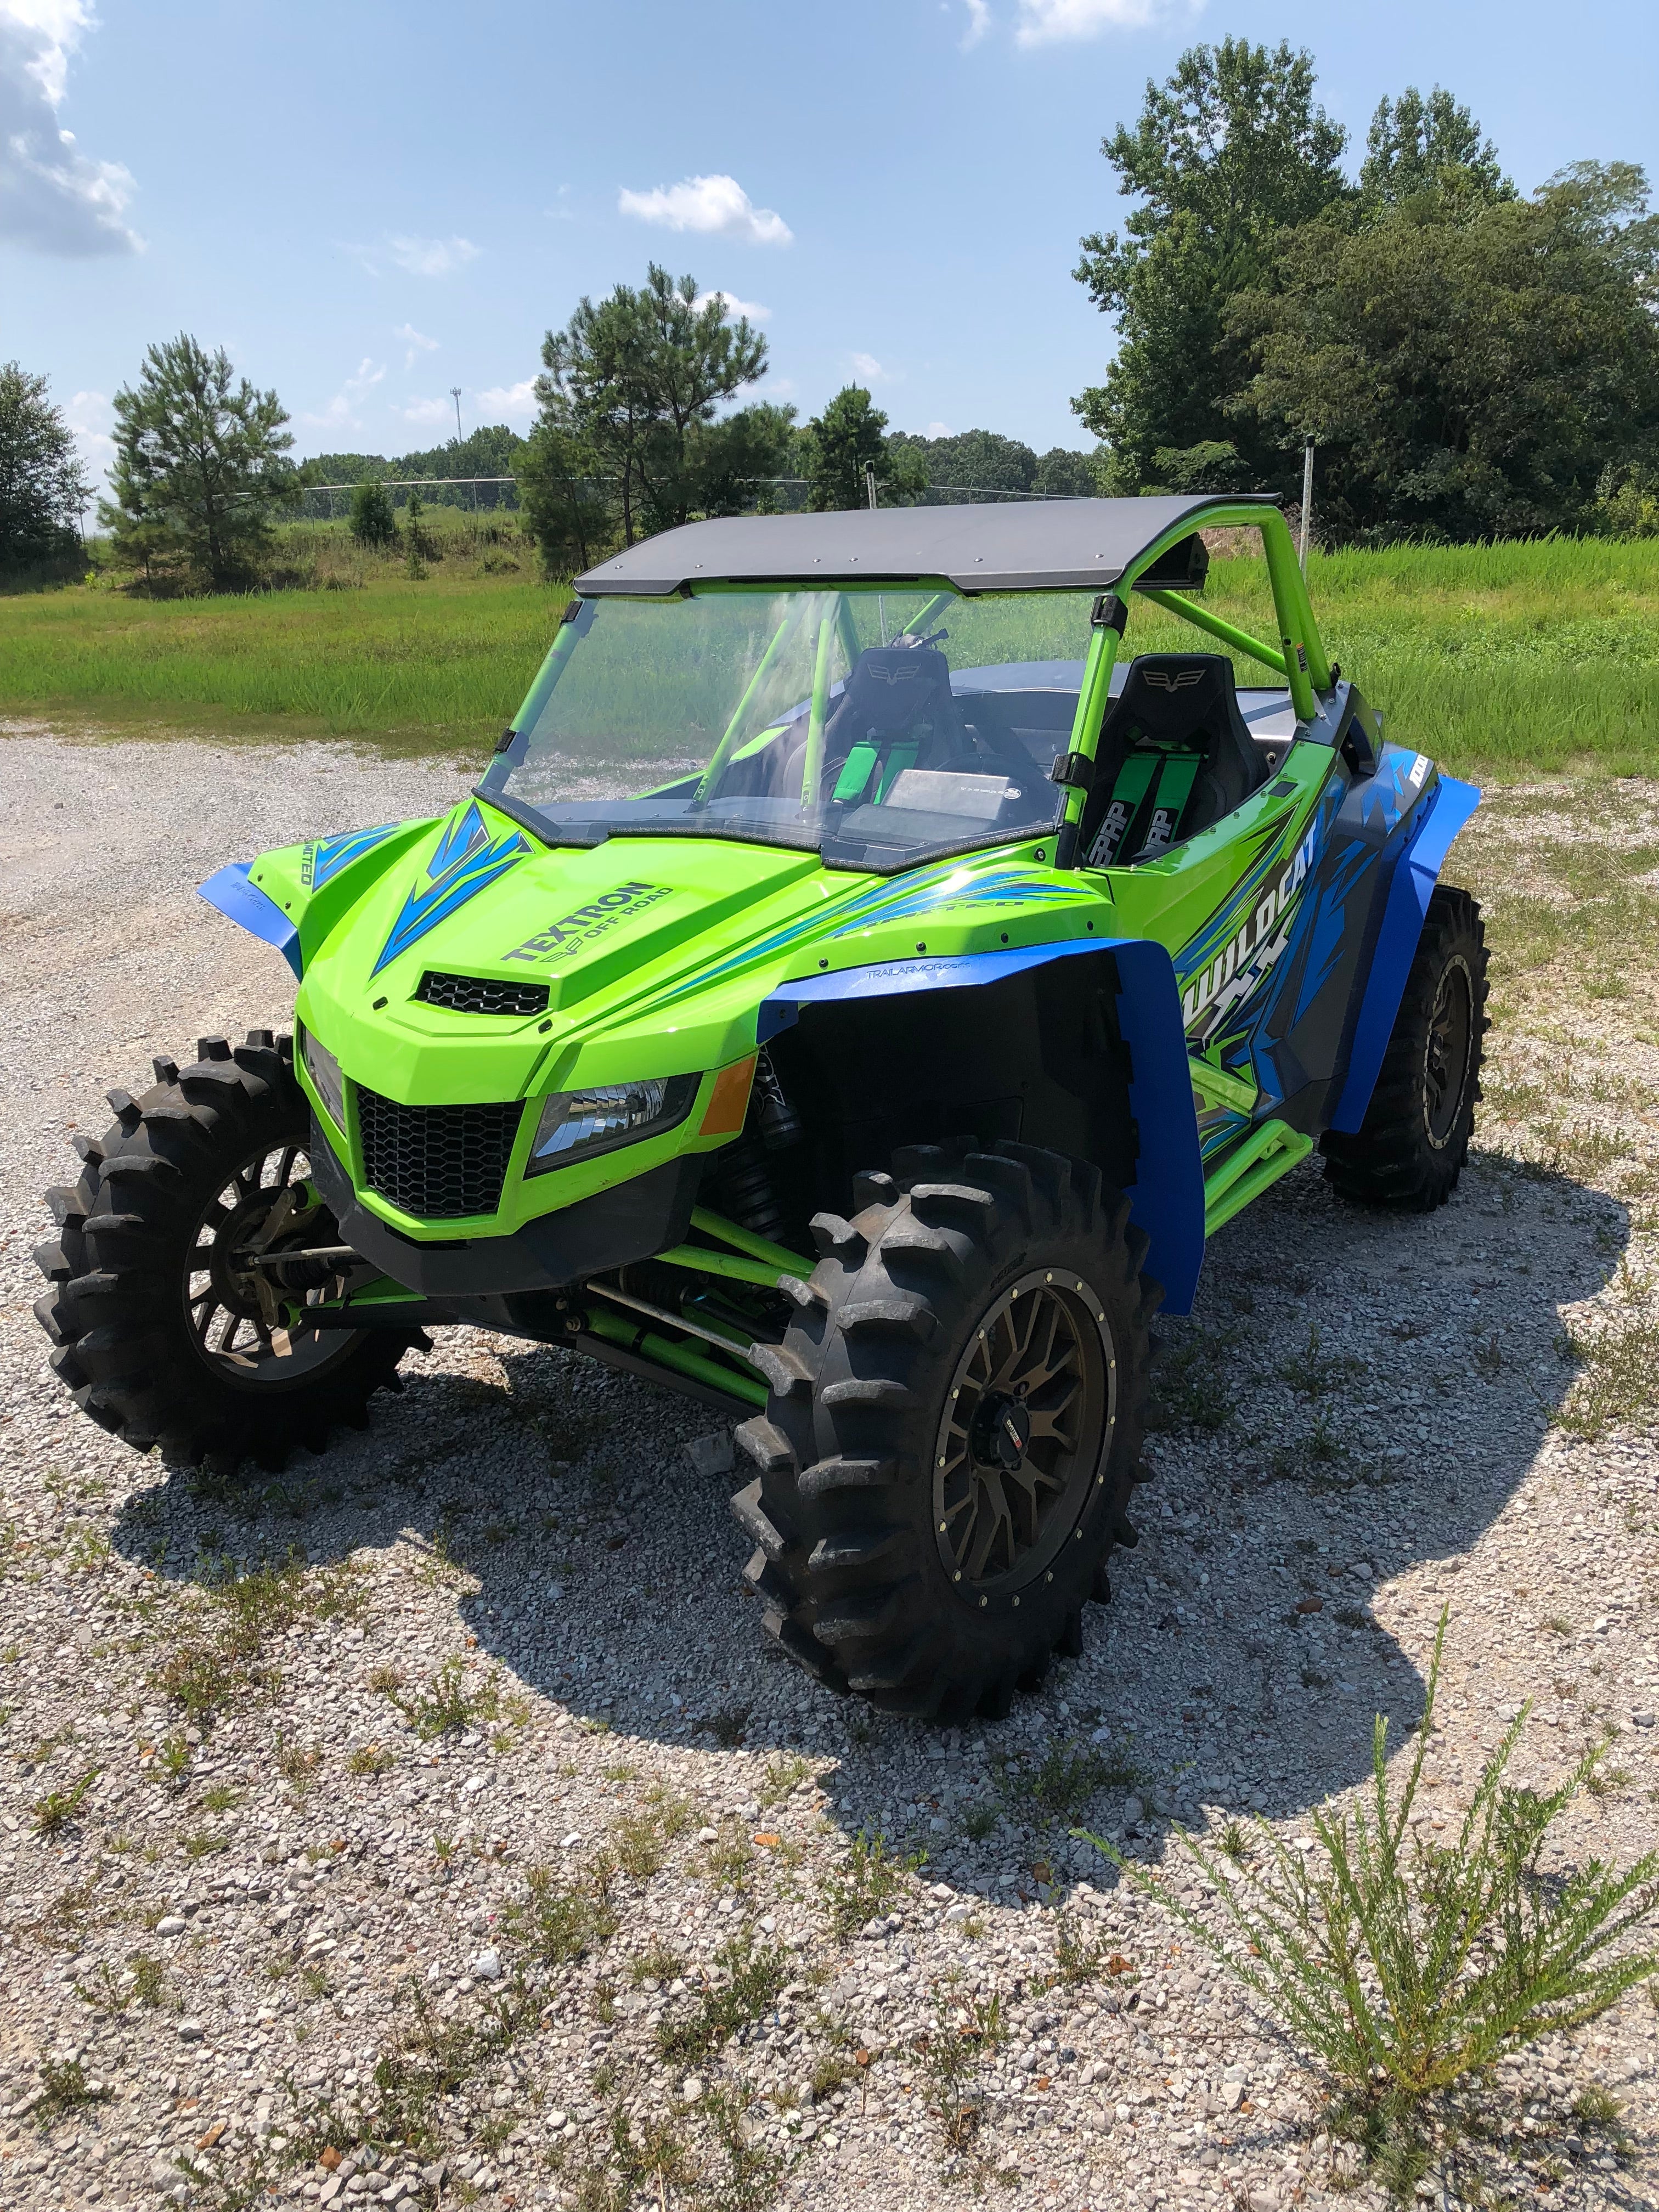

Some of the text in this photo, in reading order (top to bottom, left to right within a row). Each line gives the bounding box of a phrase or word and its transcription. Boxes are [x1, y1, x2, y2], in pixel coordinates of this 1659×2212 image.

[1144, 810, 1172, 851] RP
[301, 842, 314, 885] MITED
[500, 882, 656, 962] TEXTRON
[584, 887, 674, 938] OFF ROAD
[833, 901, 1024, 940] LIMITED
[1182, 816, 1317, 1029] WILDCAT
